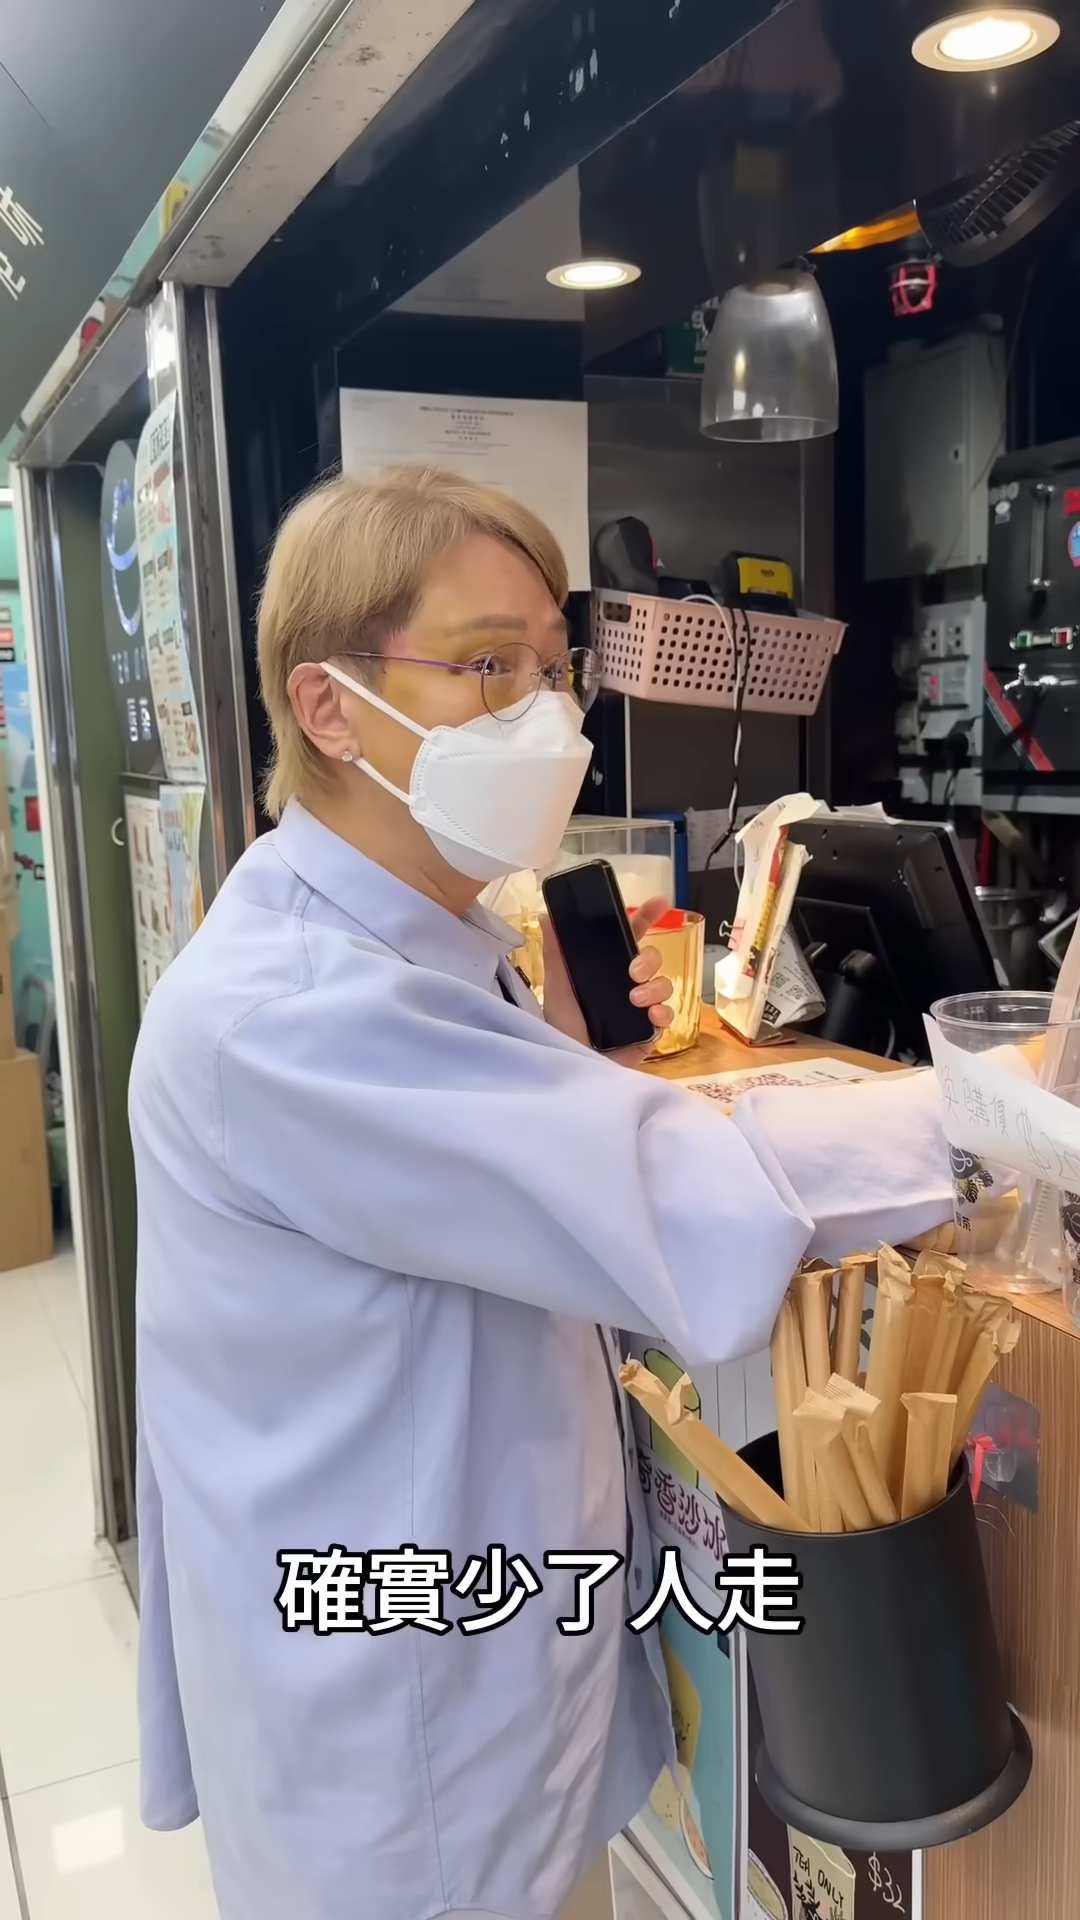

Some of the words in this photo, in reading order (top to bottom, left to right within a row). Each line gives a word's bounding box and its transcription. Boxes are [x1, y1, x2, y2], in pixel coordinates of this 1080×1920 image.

[792, 1845, 811, 1877] TEA
[817, 1869, 845, 1909] ONLY
[867, 1850, 906, 1914] $32
